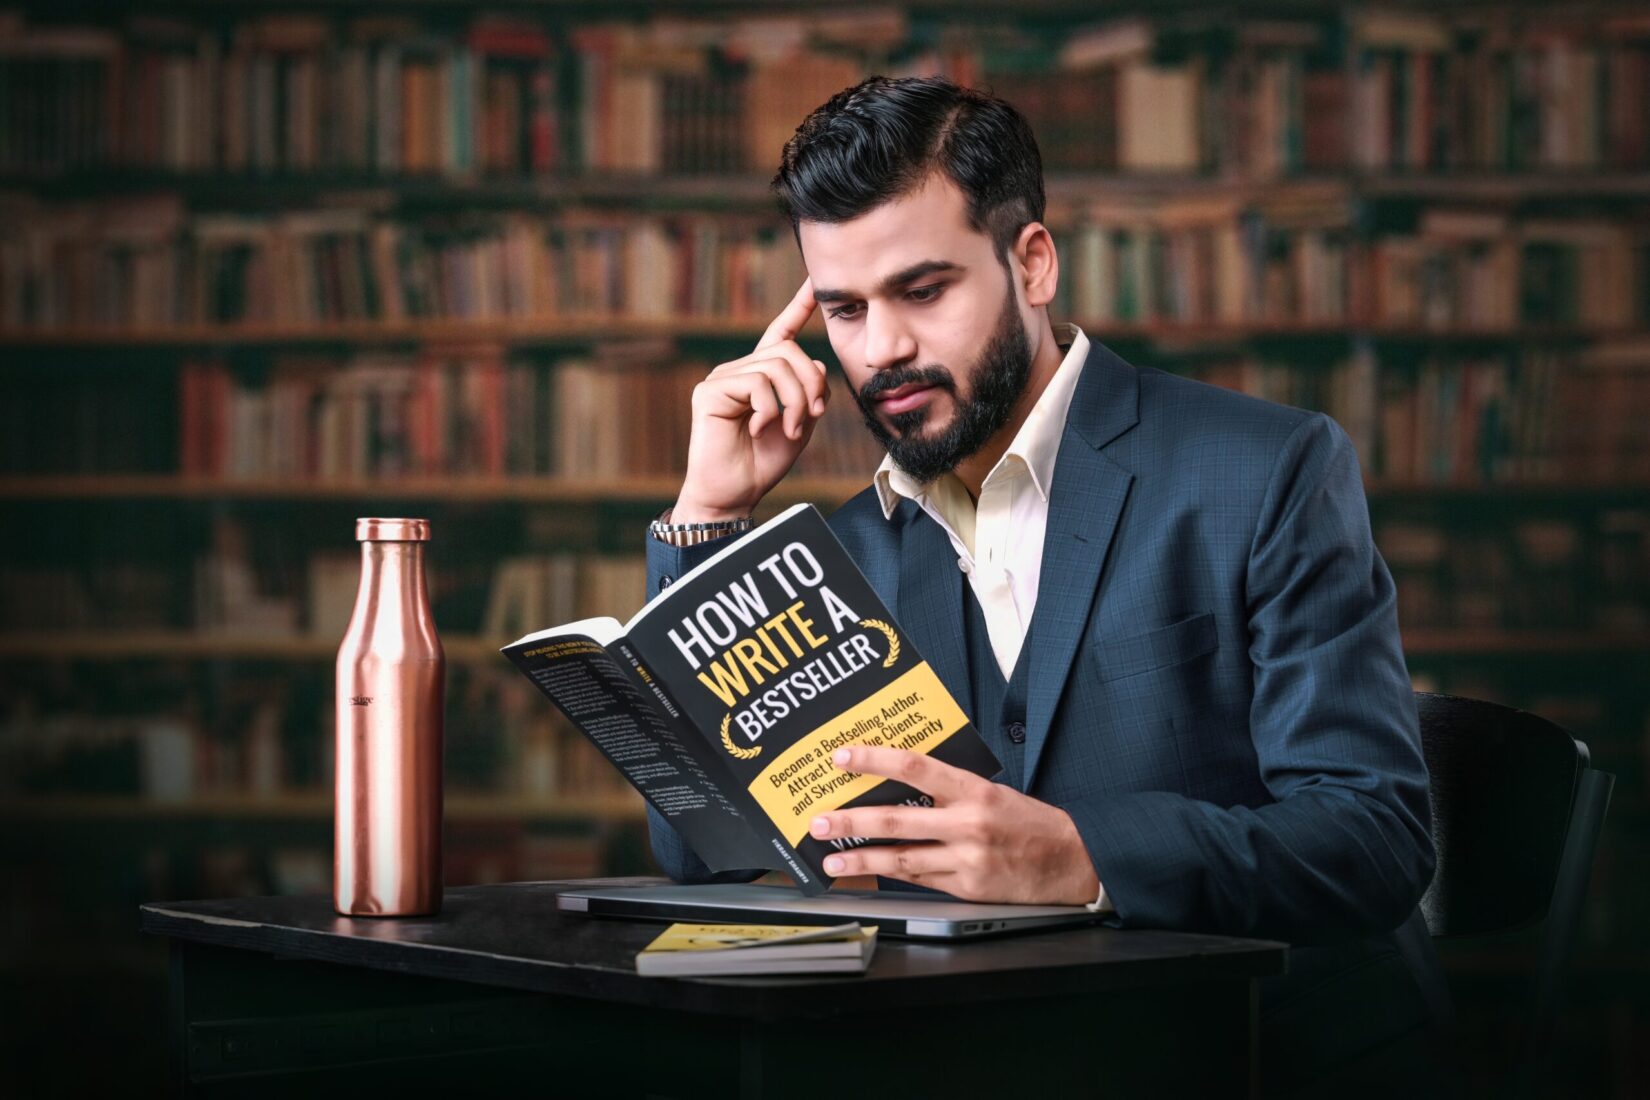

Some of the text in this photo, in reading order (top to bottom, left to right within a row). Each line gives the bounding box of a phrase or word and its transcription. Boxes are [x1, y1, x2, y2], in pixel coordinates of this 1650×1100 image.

[667, 541, 824, 671] HOW TO
[696, 600, 829, 708] WRITE
[819, 585, 861, 634] A
[636, 666, 652, 683] WRITE
[652, 687, 680, 718] BESTSELLER
[734, 633, 881, 742] BESTSELLER
[769, 750, 815, 789] Become
[813, 747, 824, 758] a
[820, 714, 885, 753] Bestselling
[880, 690, 924, 721] Author,
[787, 763, 828, 797] Attract
[881, 711, 927, 741] Clients,
[791, 787, 814, 816] and
[811, 770, 862, 799] Skyrock
[891, 718, 944, 751] uthority
